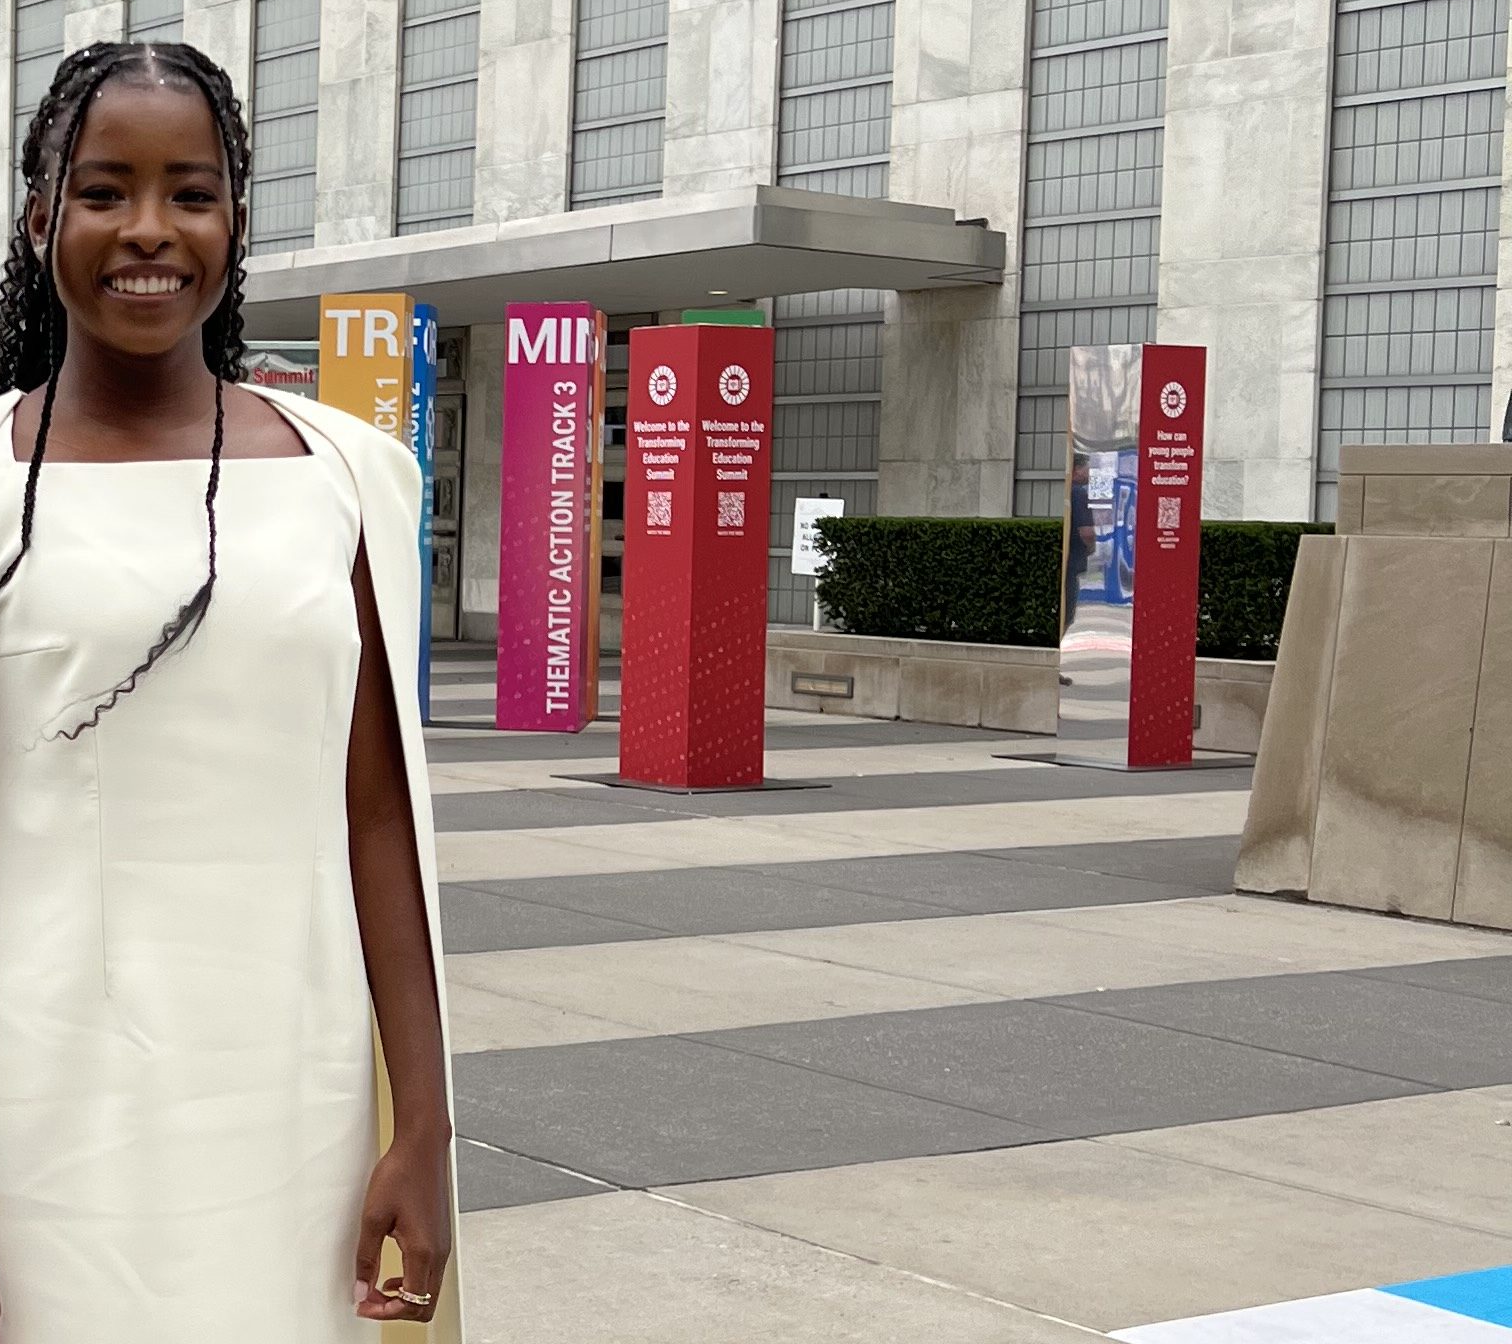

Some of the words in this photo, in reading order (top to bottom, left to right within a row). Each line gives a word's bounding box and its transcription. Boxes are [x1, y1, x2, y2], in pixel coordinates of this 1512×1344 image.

[325, 309, 406, 357] TR
[253, 367, 315, 384] Summit
[553, 381, 577, 395] 3
[633, 420, 667, 432] Welcome
[668, 421, 676, 432] to
[677, 420, 690, 432] the
[702, 419, 739, 432] Welcome
[740, 421, 749, 432] to
[751, 420, 765, 432] the
[1157, 430, 1173, 441] How
[1174, 433, 1187, 441] can
[551, 402, 577, 484] TRACK
[637, 436, 686, 451] Transforming
[706, 436, 760, 451] Transforming
[642, 452, 679, 464] Education
[712, 452, 753, 464] Education
[646, 468, 675, 480] Summit
[716, 468, 748, 480] Summit
[549, 490, 574, 583] ACTION
[546, 588, 571, 714] THEMATIC
